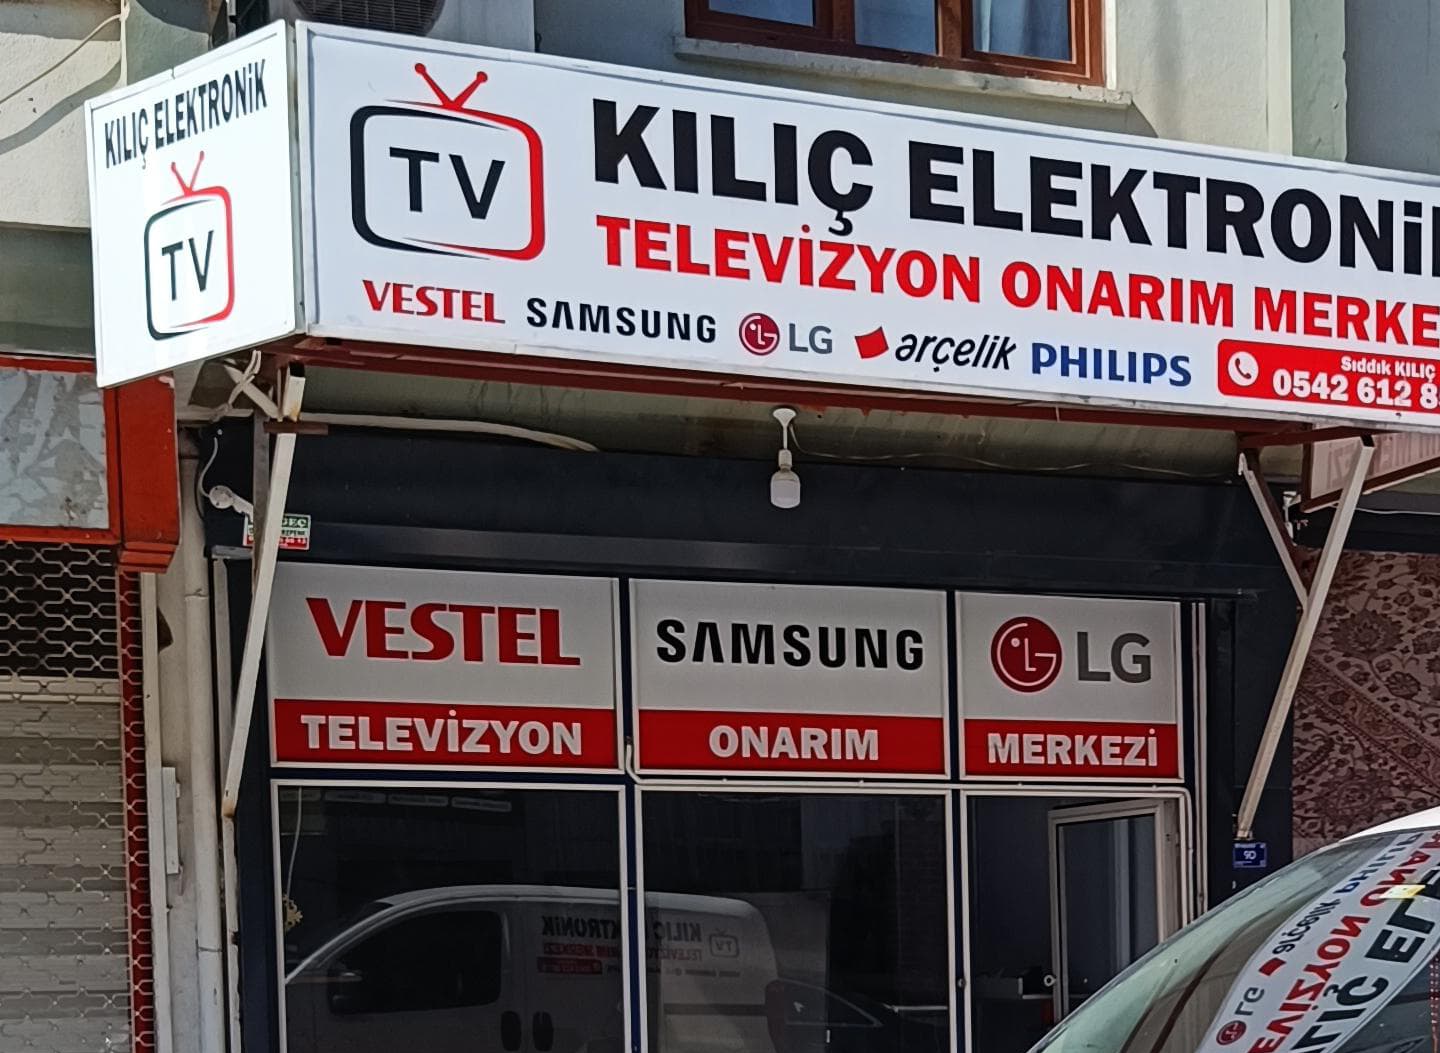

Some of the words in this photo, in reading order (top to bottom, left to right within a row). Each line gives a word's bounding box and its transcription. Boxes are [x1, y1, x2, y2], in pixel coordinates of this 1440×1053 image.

[104, 110, 151, 169] KILIÇ
[592, 98, 874, 236] KILIÇ
[389, 147, 506, 219] TV
[161, 230, 214, 301] TV
[597, 215, 981, 303] TELEVİZYON
[1001, 260, 1233, 328] ONARIM
[362, 279, 505, 324] VESTEL
[526, 297, 717, 344] SAMSUNG
[789, 321, 833, 355] LG
[895, 332, 1016, 370] arçelik
[1031, 342, 1192, 387] PHILIPS
[1272, 369, 1349, 402] 0542
[1356, 377, 1412, 408] 612
[1394, 361, 1436, 382] KILIÇ
[305, 597, 580, 667] VESTEL
[656, 618, 925, 673] SAMSUNG
[1076, 631, 1152, 684] LG
[300, 709, 582, 757] TELEVİZYON
[708, 725, 879, 762] ONARIM
[986, 728, 1158, 768] MERKEZİ
